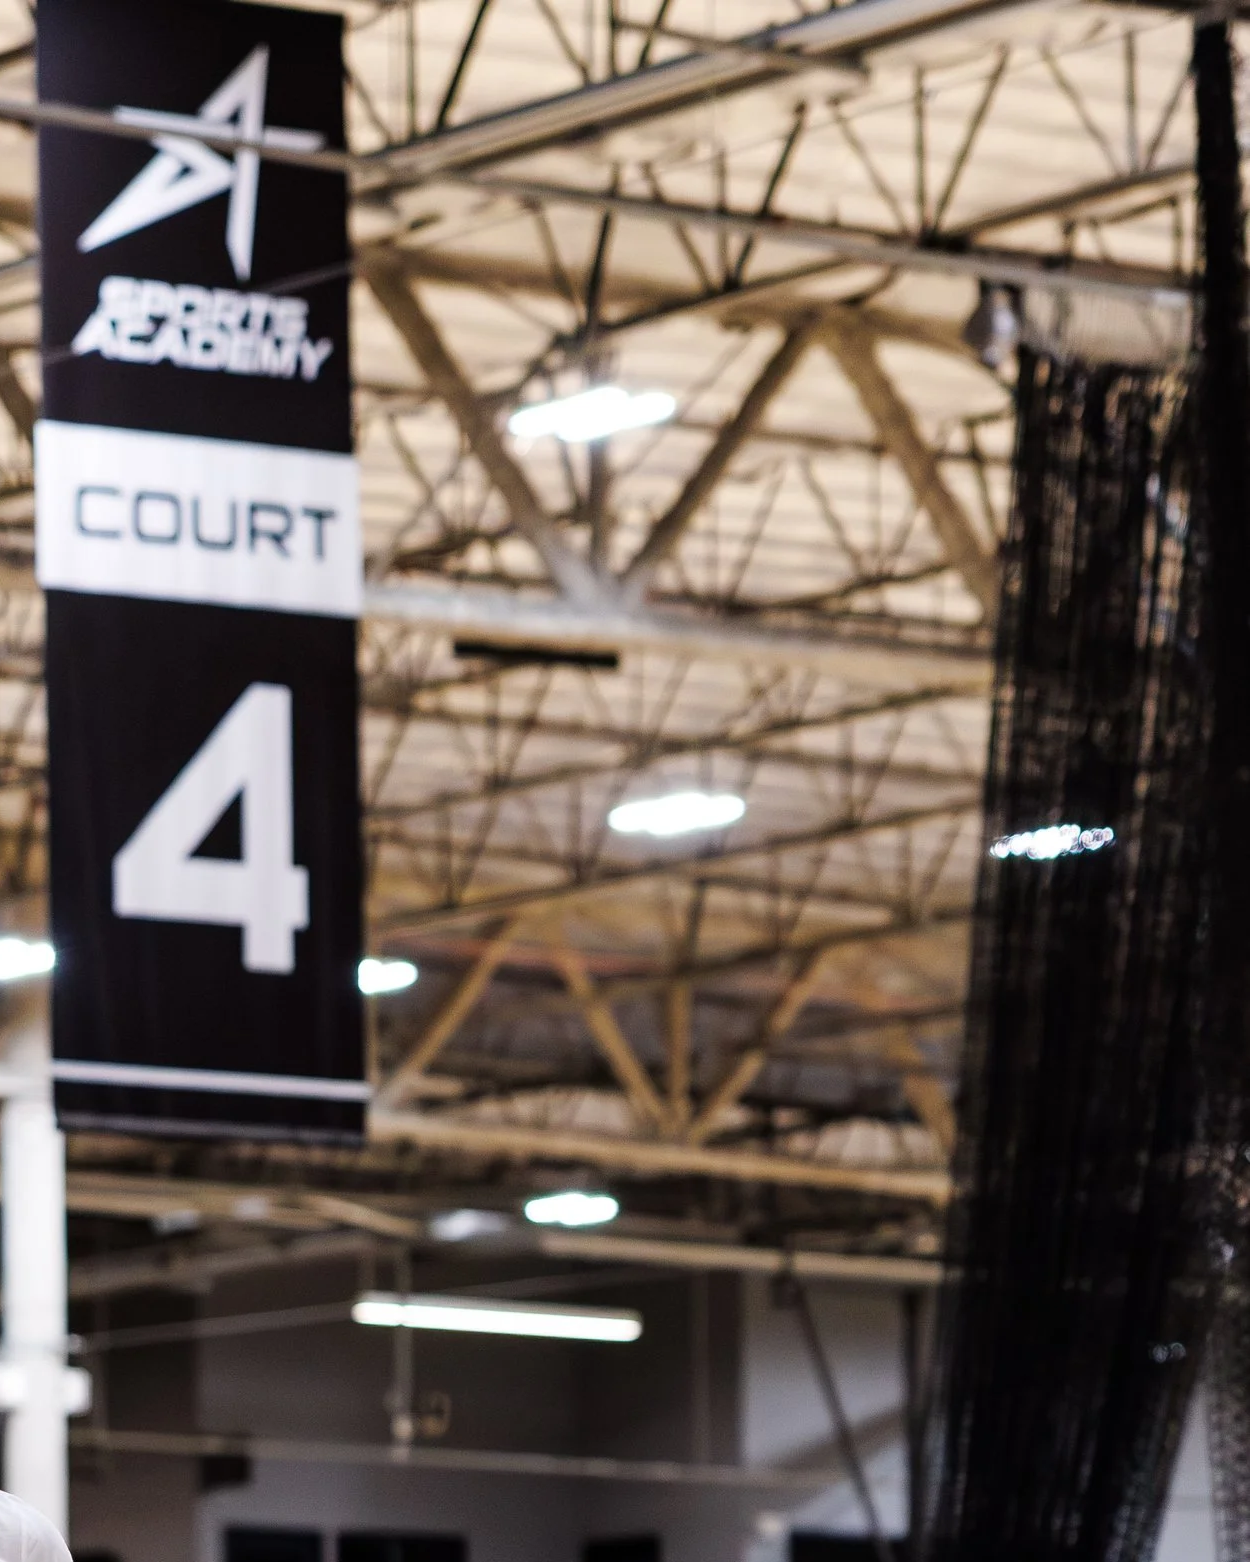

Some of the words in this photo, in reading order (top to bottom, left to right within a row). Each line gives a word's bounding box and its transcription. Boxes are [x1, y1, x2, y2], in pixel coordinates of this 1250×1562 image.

[98, 274, 310, 337] SPORTS
[71, 312, 334, 382] ACADEMY
[75, 485, 338, 561] COURT
[112, 680, 310, 975] 4
